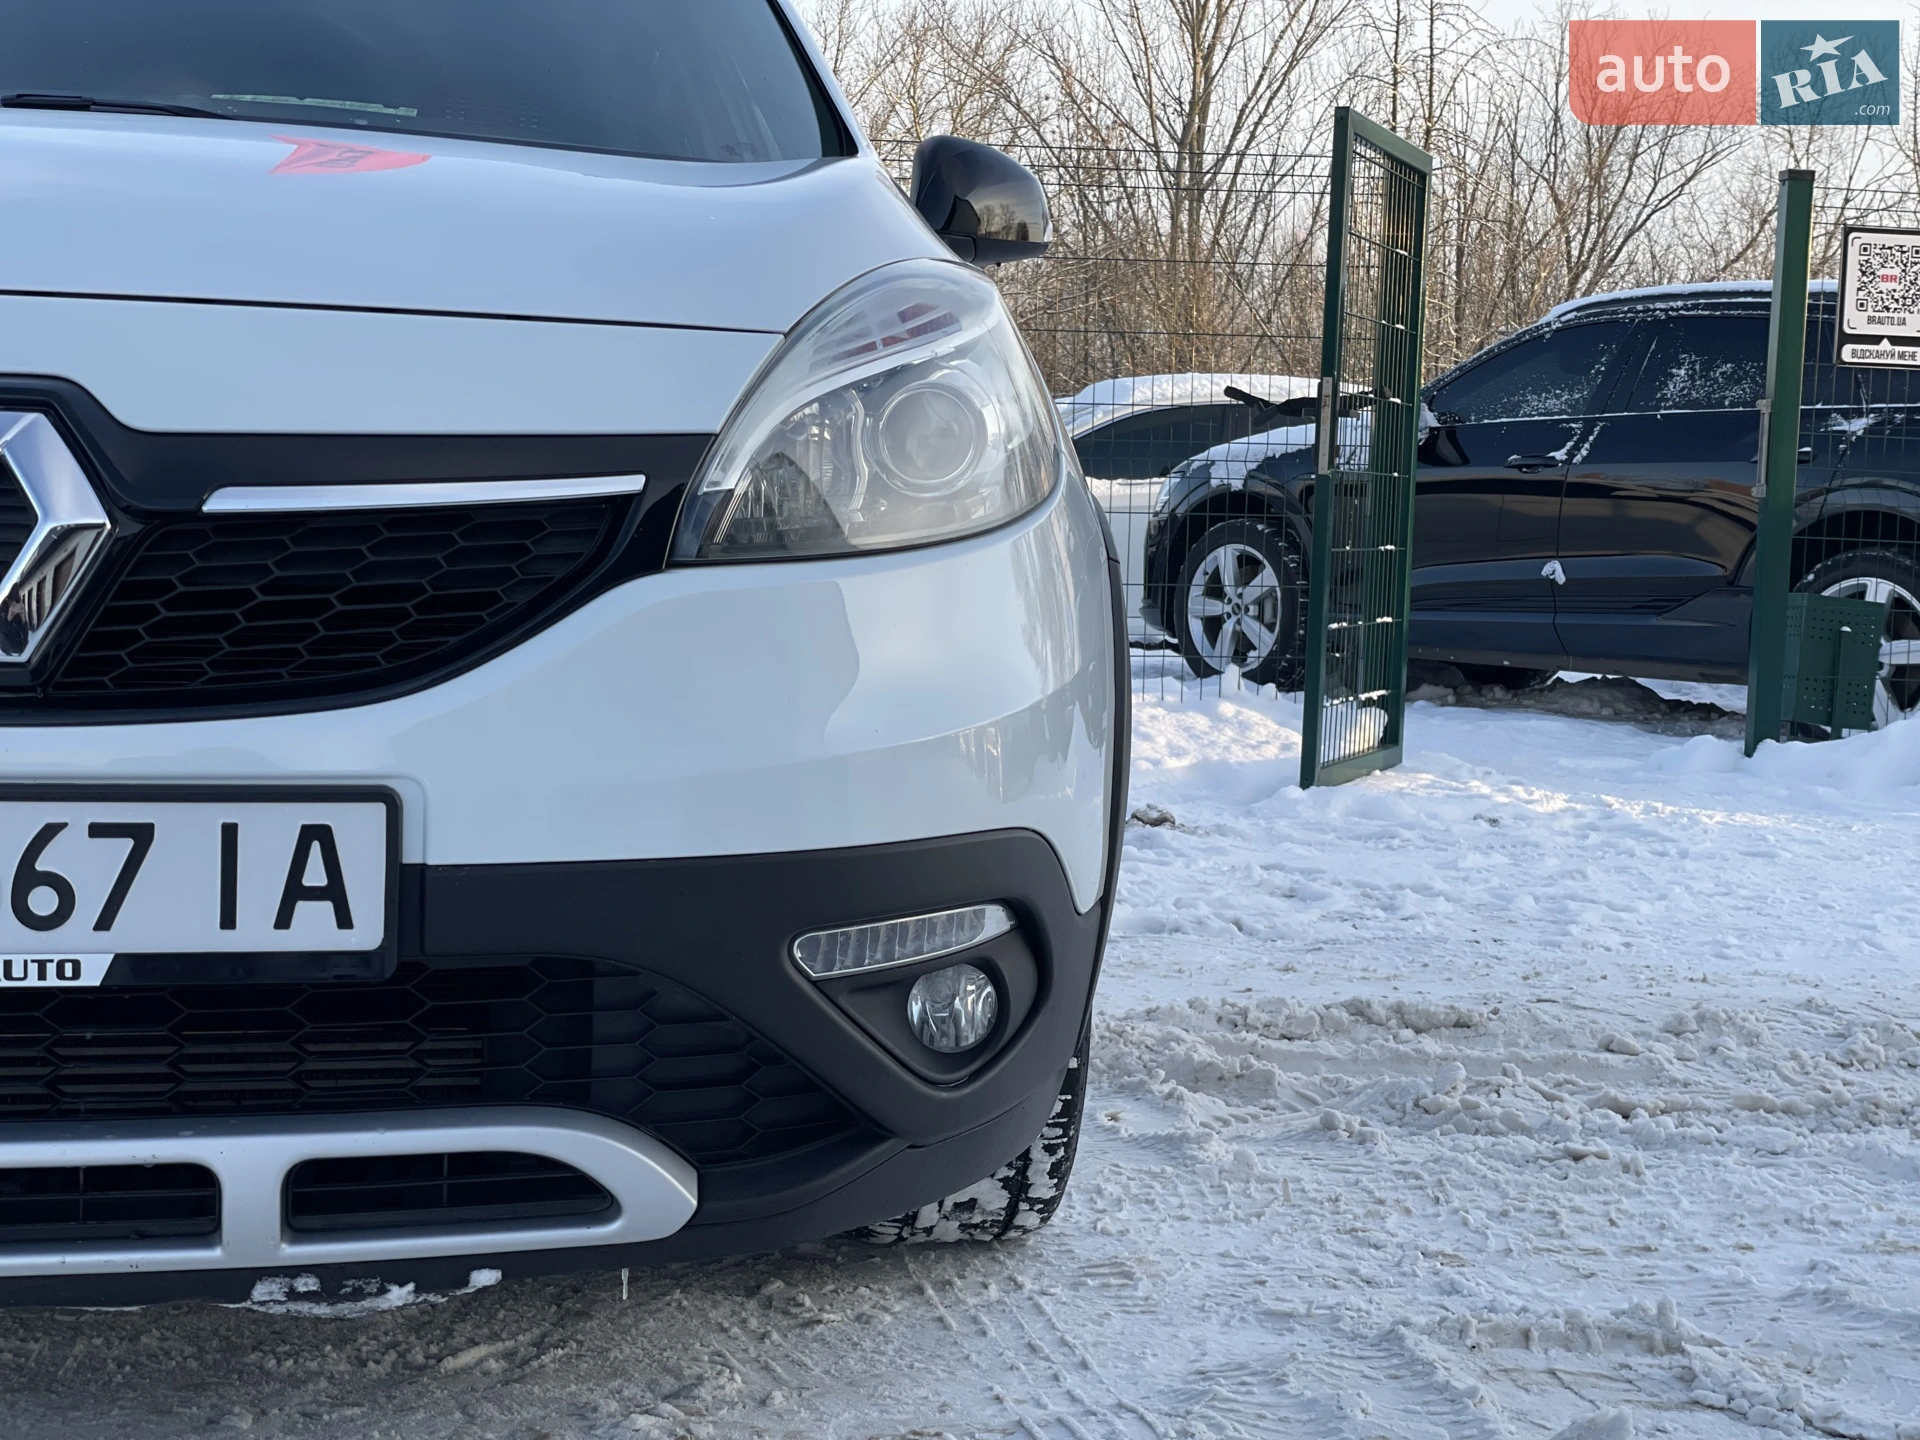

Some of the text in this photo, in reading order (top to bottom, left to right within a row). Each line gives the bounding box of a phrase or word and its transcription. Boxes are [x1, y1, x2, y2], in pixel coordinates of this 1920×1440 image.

[1880, 274, 1898, 284] BR
[1867, 315, 1907, 326] BRAUTO.UA
[1851, 348, 1918, 361] ВІДСКАНУЙ МЕНЕ
[0, 821, 354, 932] 67 IA
[0, 958, 82, 981] UTO
